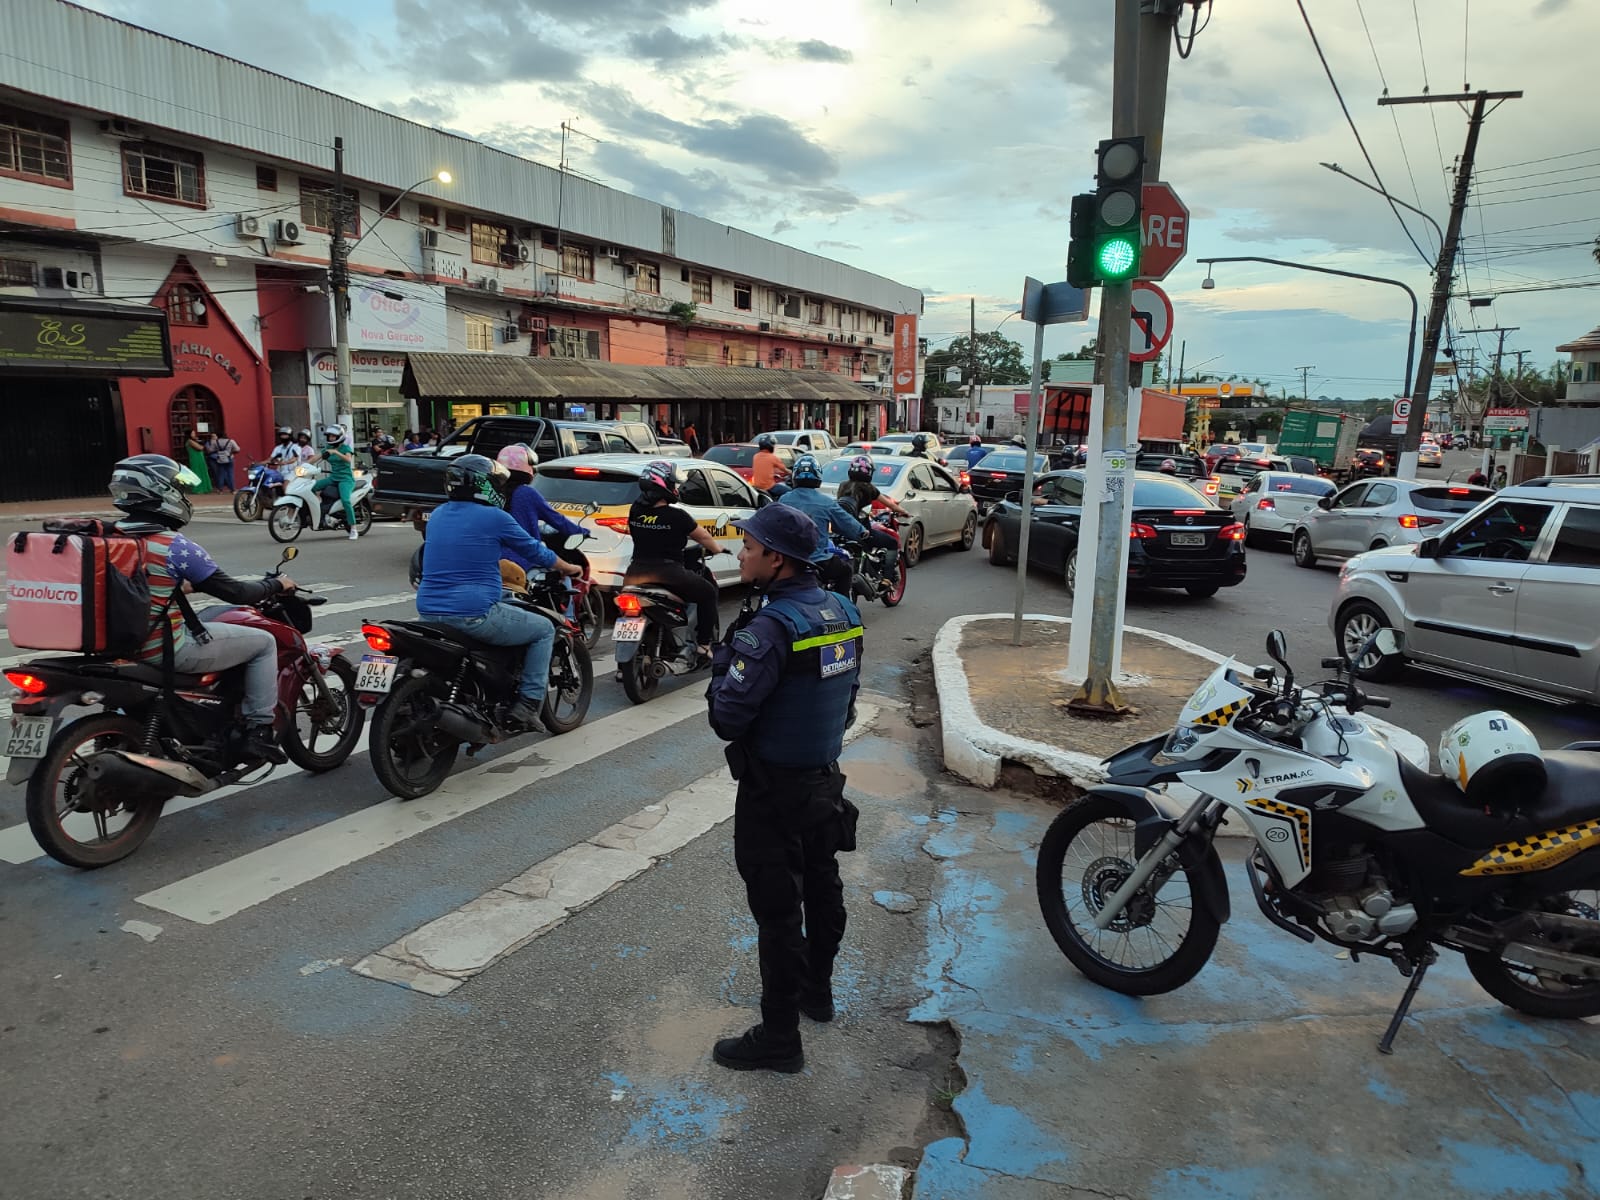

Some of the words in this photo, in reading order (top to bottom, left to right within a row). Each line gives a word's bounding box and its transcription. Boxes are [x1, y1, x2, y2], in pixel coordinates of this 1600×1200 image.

[360, 328, 384, 341] Nova
[386, 330, 424, 345] Geração
[317, 360, 338, 372] Otic
[351, 353, 378, 366] Nova
[382, 355, 406, 367] Gera
[1400, 403, 1408, 414] E
[1488, 408, 1527, 416] ATENÇÃO
[704, 525, 728, 537] SCOLA
[10, 584, 78, 602] tonolucro
[359, 675, 387, 688] 8F54
[1488, 719, 1509, 732] 47
[6, 739, 42, 756] 6254
[1263, 769, 1314, 785] ETRAN.AC
[1269, 830, 1286, 839] 20
